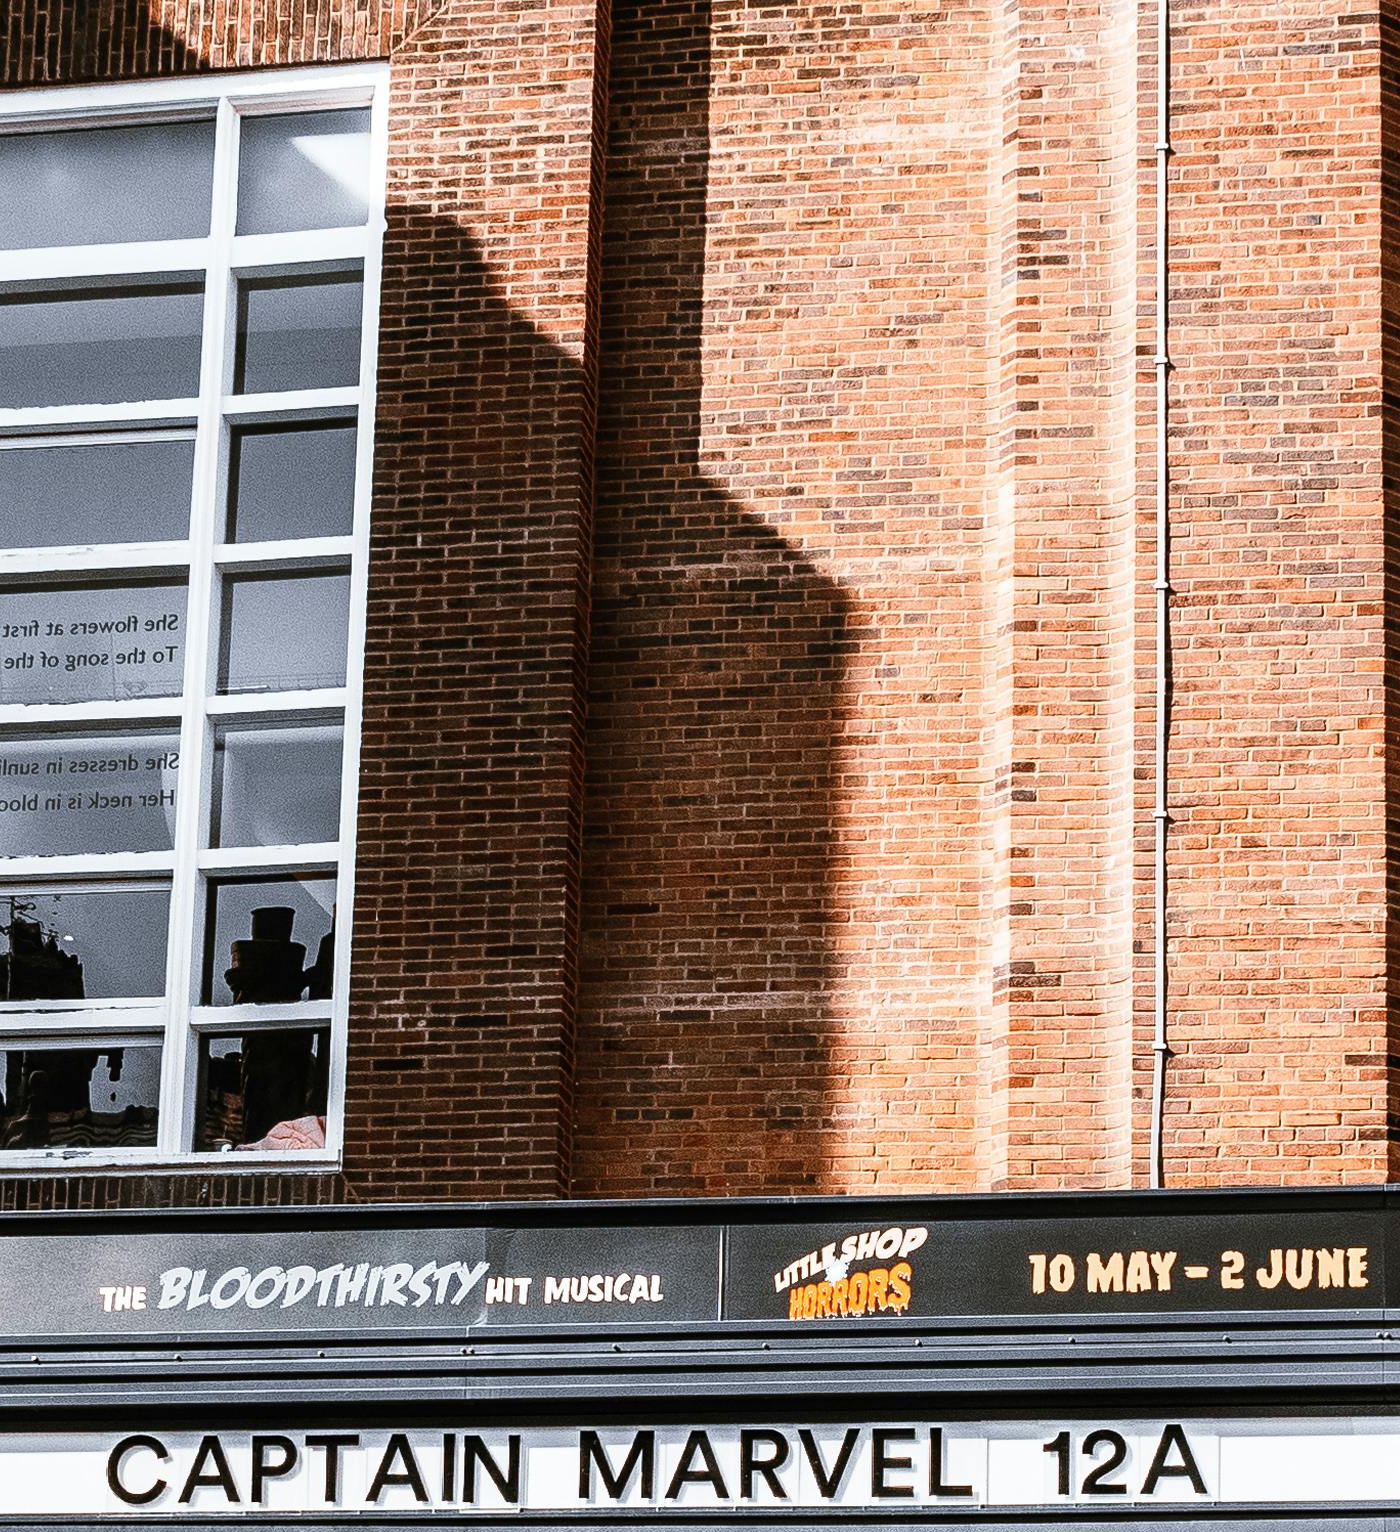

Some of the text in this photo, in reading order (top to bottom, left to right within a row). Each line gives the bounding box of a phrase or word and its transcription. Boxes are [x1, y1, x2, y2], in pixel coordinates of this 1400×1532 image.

[101, 1260, 664, 1311] THE BLOODTHIRSTY HIT MUSICAL
[774, 1227, 928, 1293] LITTLE SHOP
[1029, 1247, 1370, 1294] 10 MAY 2 JUNE
[789, 1263, 912, 1320] HORRORS
[105, 1424, 1212, 1508] CAPTAIN MARVEL 12A
